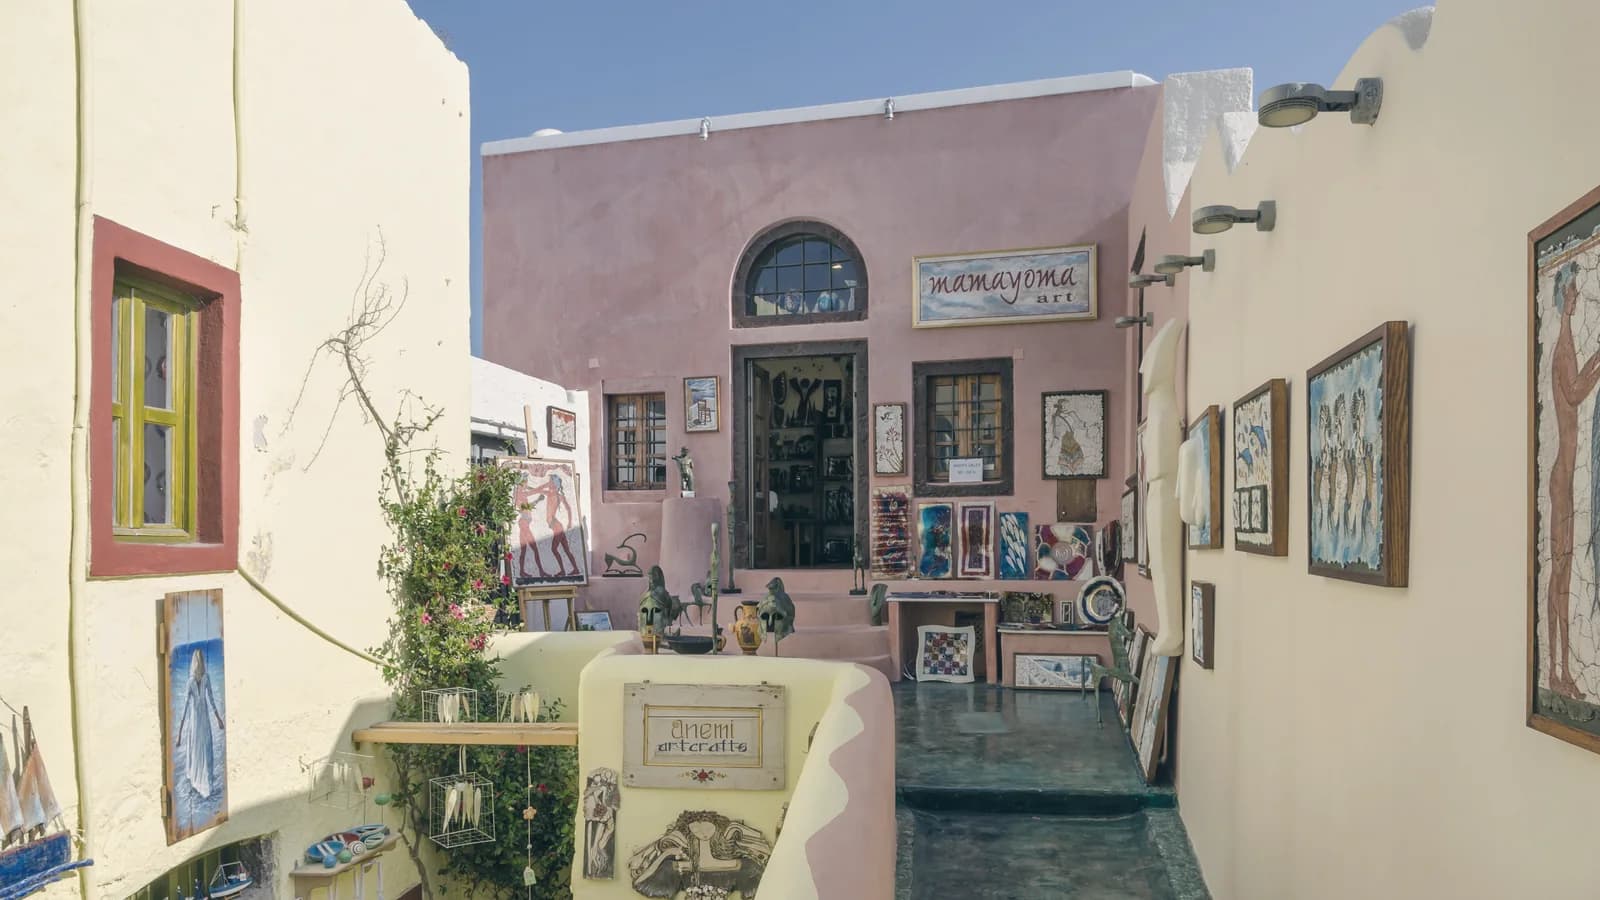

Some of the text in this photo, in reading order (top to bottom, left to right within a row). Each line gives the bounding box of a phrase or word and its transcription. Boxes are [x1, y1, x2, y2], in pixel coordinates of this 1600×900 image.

[930, 266, 1077, 304] mamayoma
[1036, 292, 1074, 304] art
[671, 719, 735, 739] anemi
[657, 739, 748, 753] artcrafts
